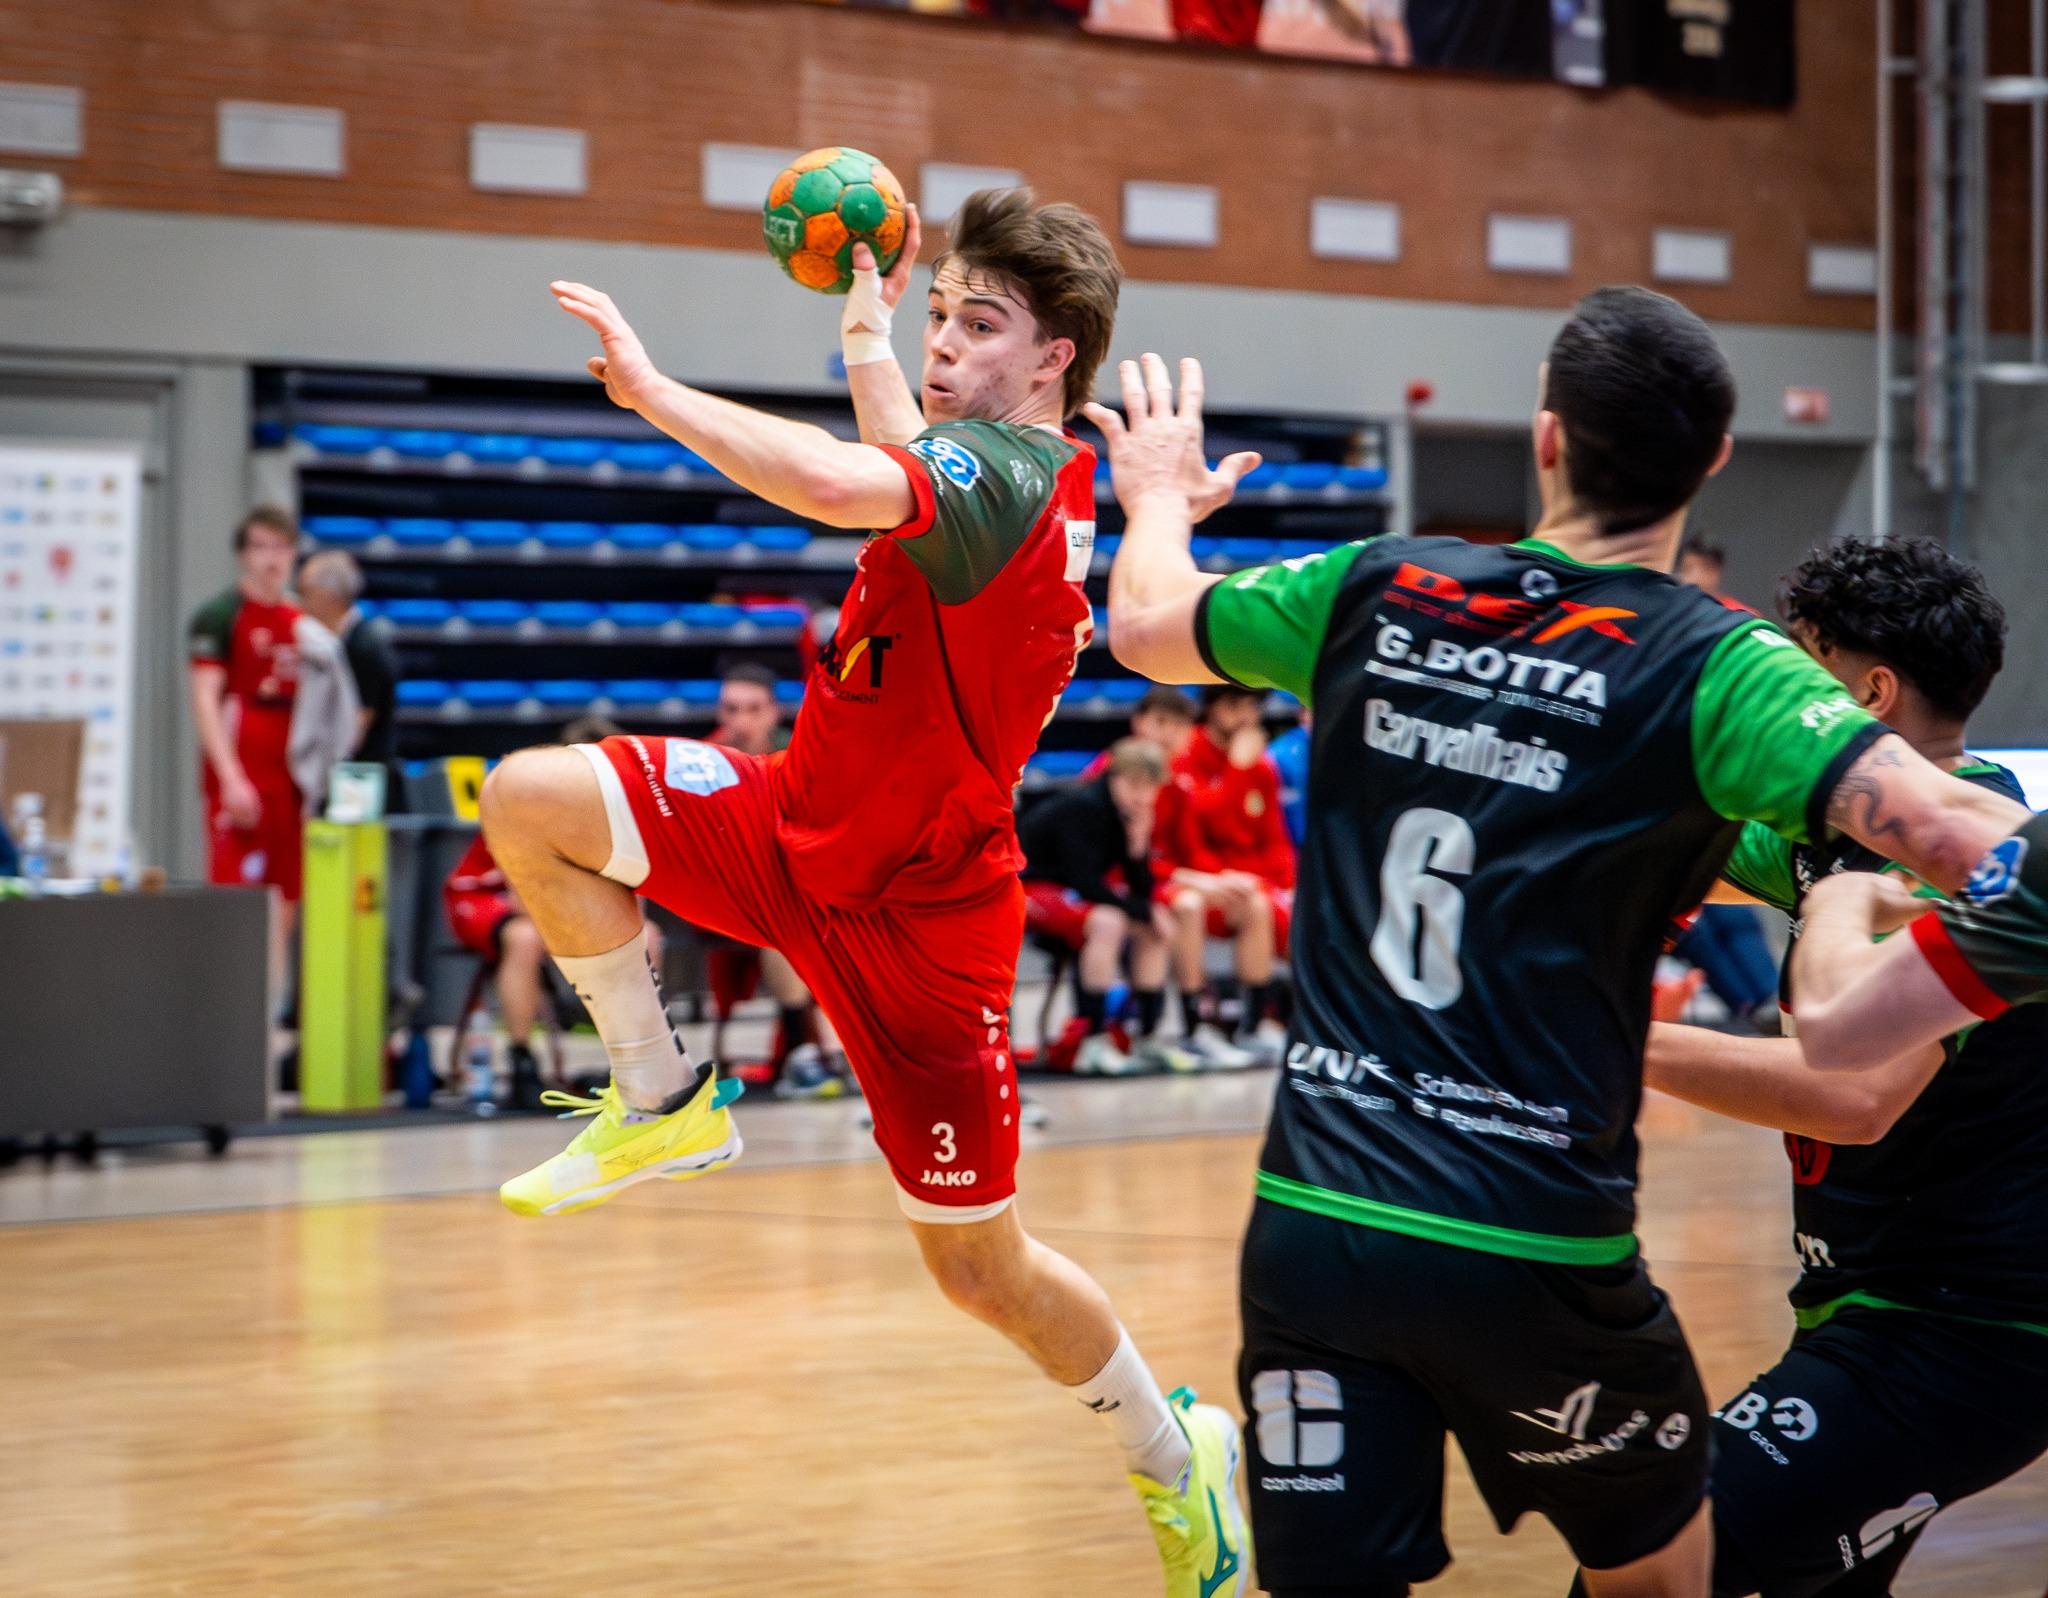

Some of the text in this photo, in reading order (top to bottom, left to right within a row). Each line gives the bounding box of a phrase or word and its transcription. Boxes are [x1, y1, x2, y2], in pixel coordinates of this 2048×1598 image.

[1375, 623, 1608, 708] G.BOTTA
[1363, 698, 1568, 792] Carvalhais
[1369, 807, 1477, 1011] 6
[921, 1169, 977, 1187] JAKO
[931, 1121, 957, 1164] 3
